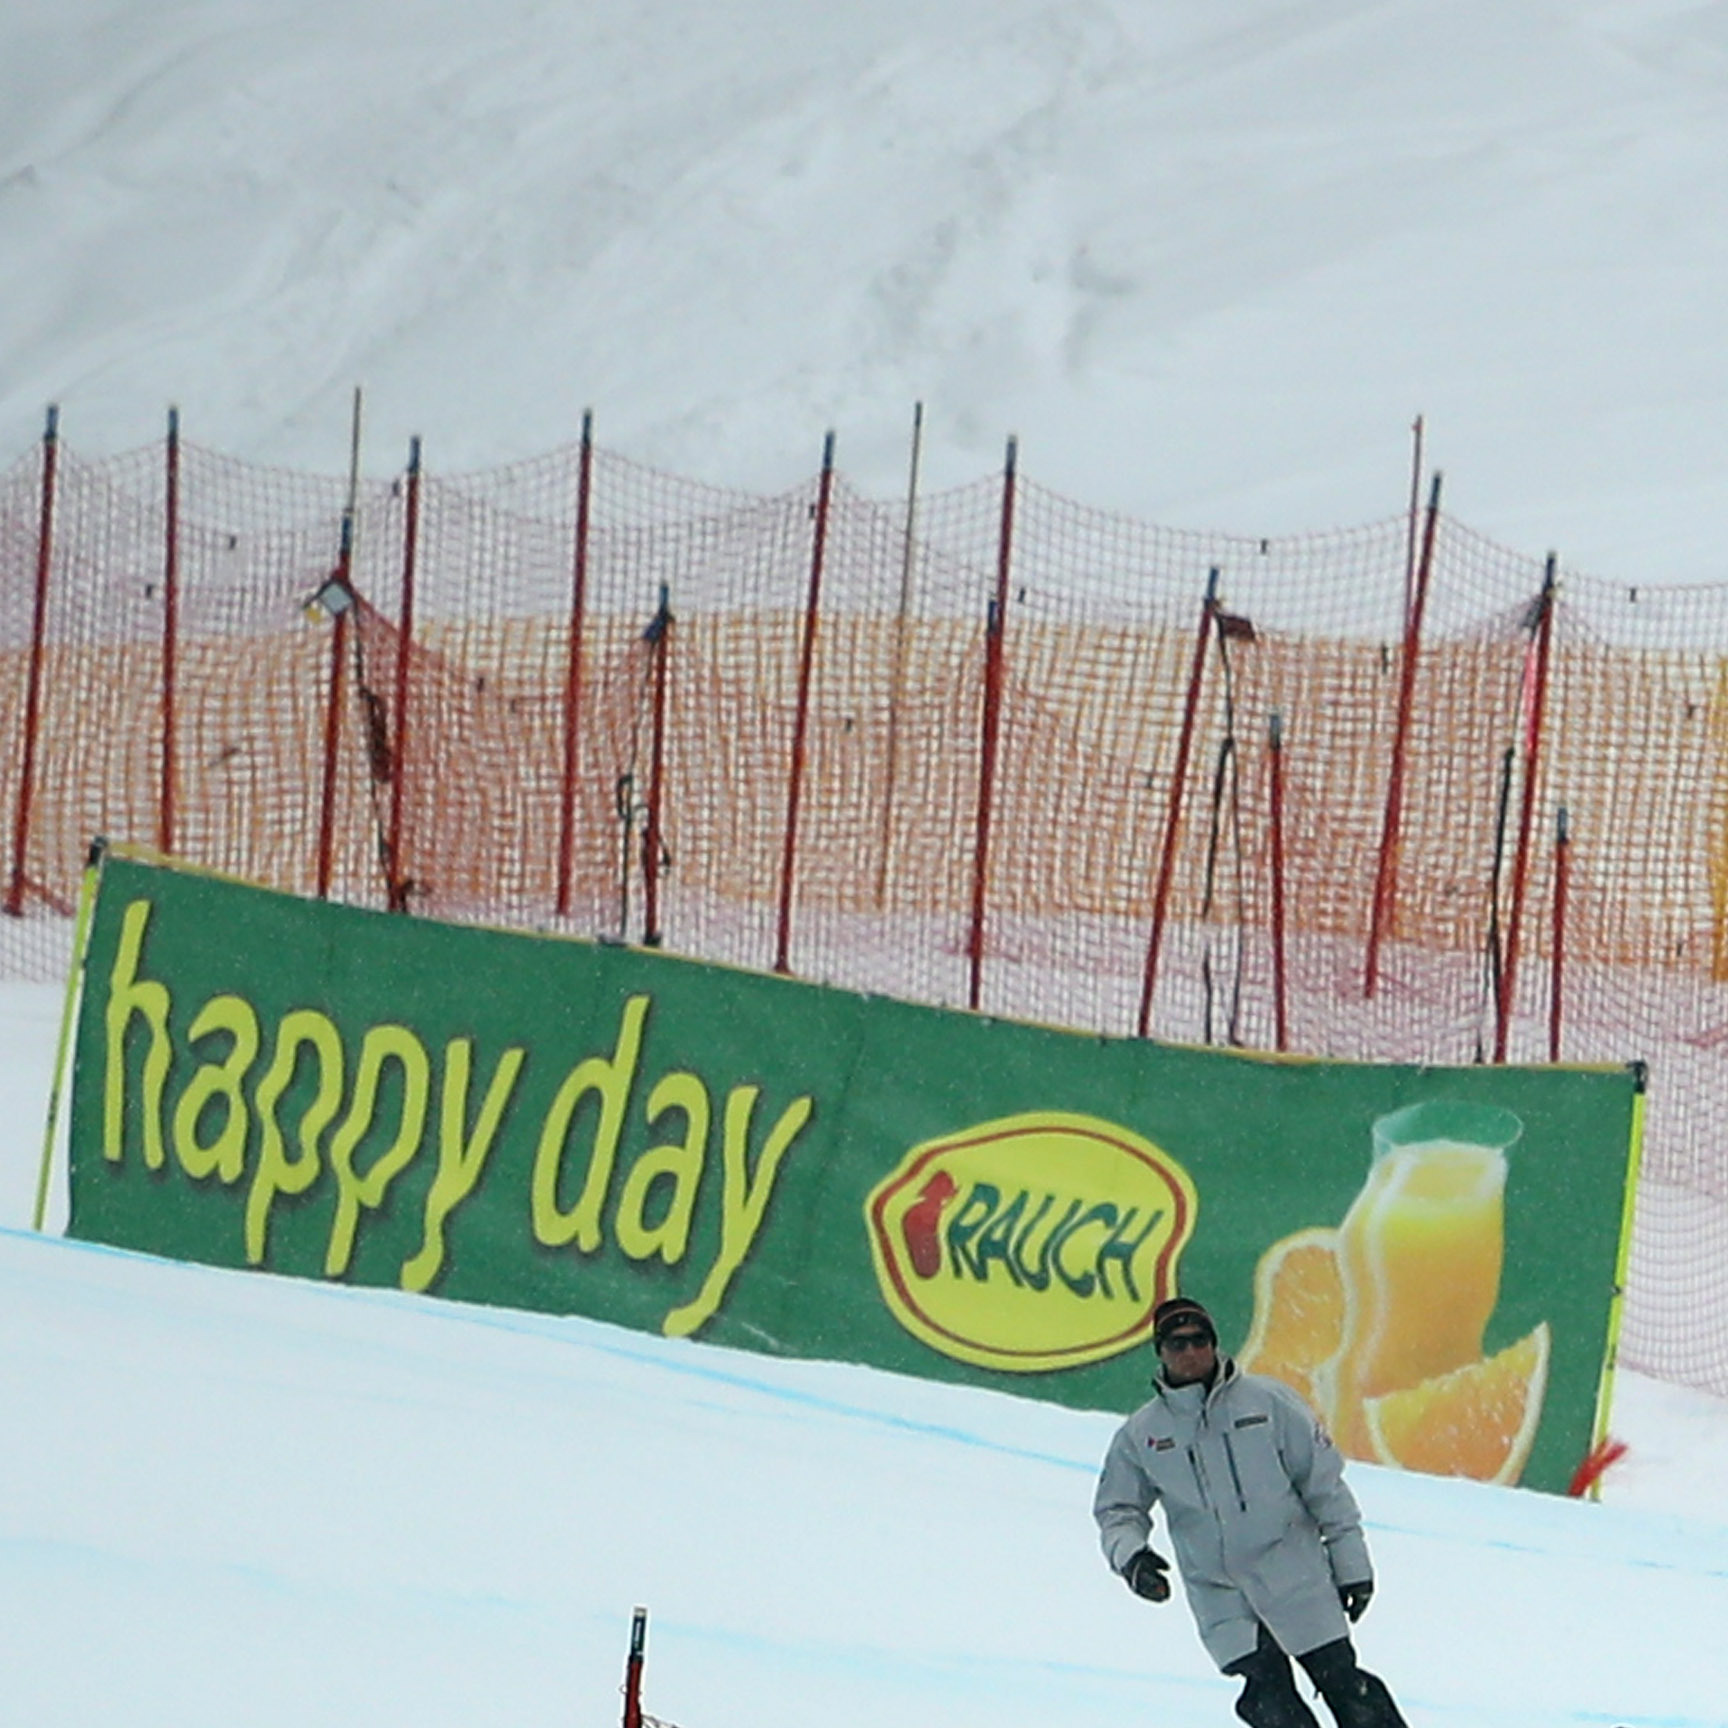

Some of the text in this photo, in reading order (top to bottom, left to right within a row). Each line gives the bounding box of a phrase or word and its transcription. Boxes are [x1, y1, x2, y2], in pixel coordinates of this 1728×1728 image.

[105, 899, 813, 1337] happy day
[947, 1182, 1164, 1303] RAUCH
